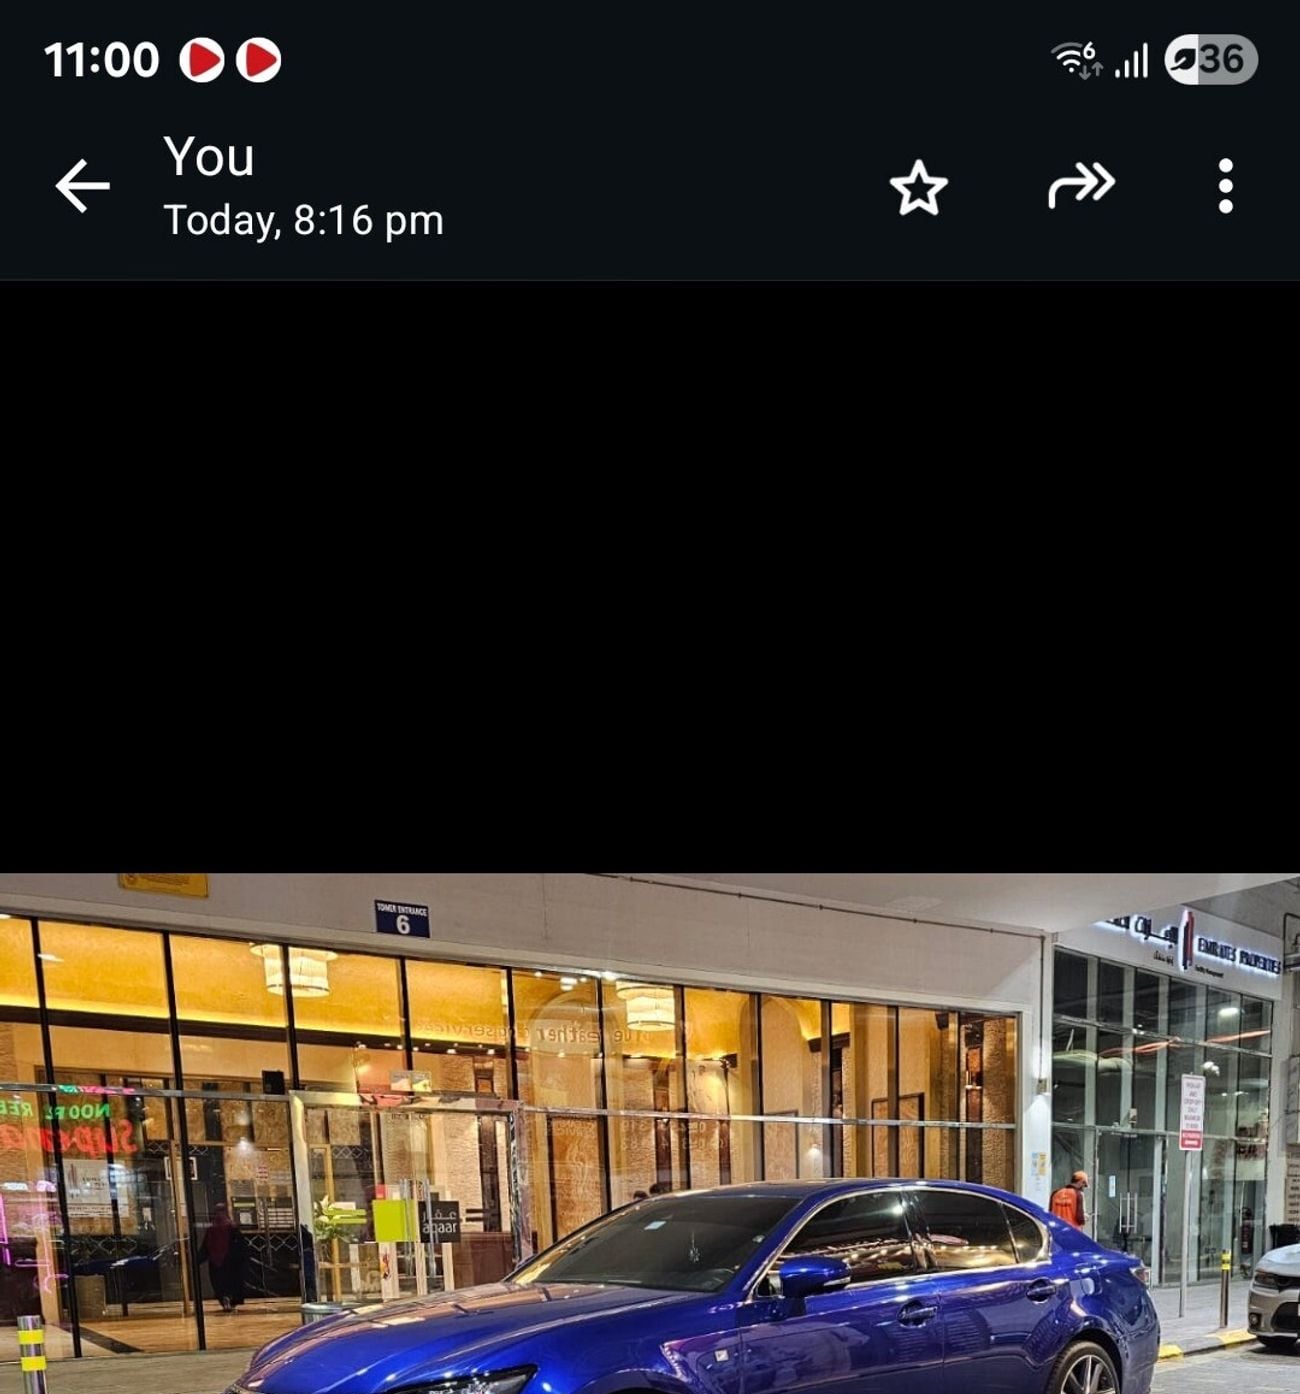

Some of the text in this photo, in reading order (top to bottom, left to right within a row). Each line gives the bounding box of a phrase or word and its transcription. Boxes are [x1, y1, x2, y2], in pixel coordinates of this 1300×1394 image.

[377, 902, 428, 917] TOWER ENTRANCE
[396, 914, 410, 934] 6
[1198, 937, 1236, 962] EMIRATES
[1239, 949, 1281, 975] PROPERTIES
